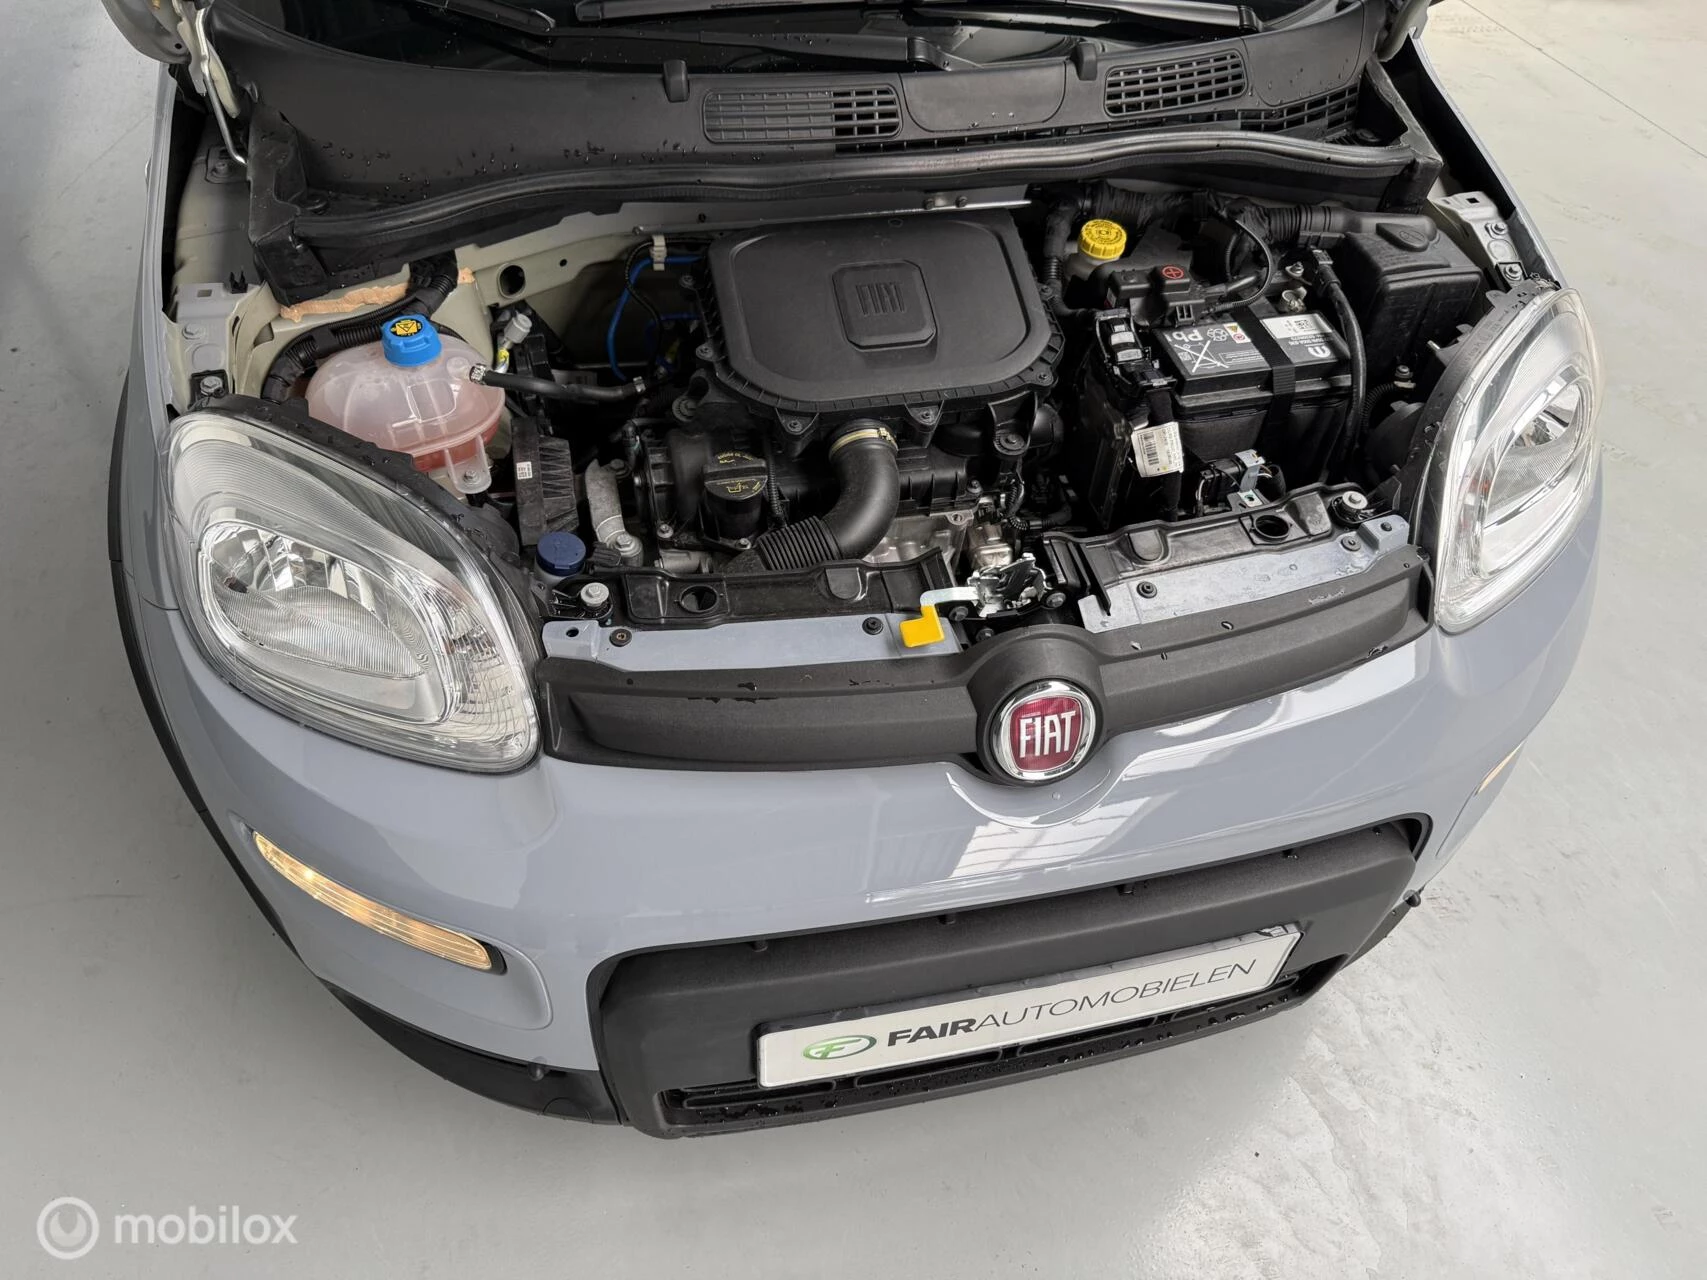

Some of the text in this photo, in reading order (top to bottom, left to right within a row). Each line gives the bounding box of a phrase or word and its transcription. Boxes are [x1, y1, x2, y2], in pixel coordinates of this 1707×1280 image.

[855, 281, 906, 316] FIAT
[1172, 329, 1204, 342] Pb
[1019, 710, 1077, 758] FIAT
